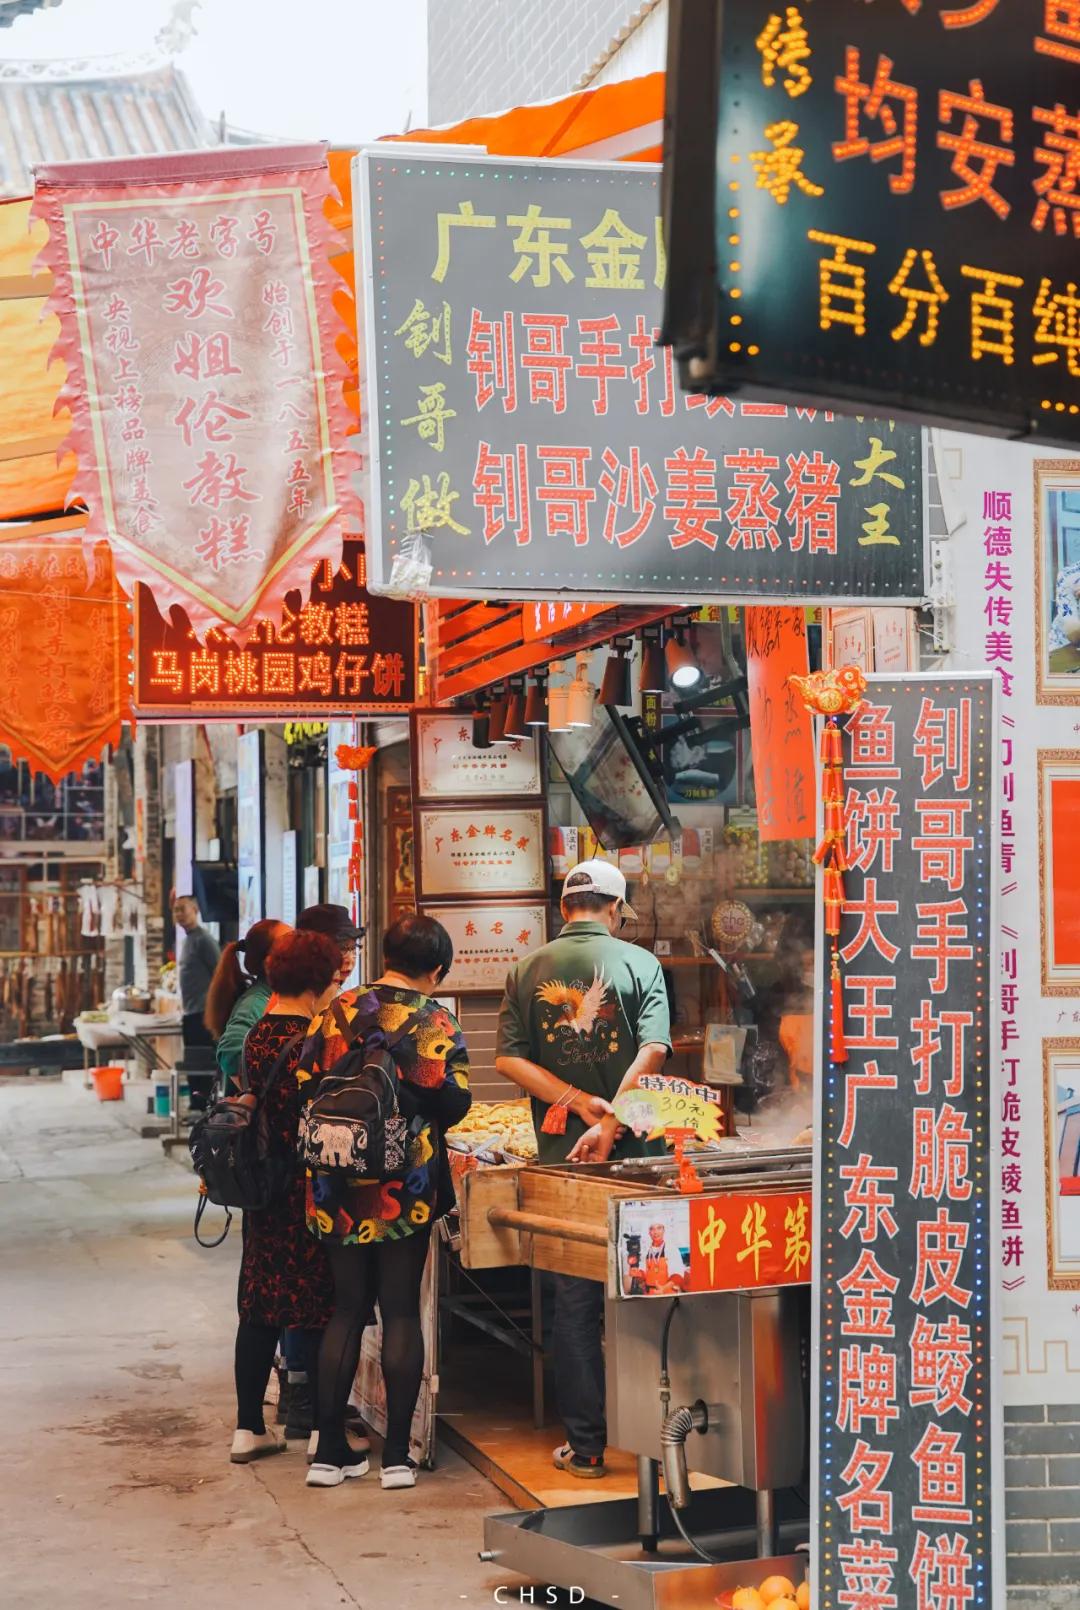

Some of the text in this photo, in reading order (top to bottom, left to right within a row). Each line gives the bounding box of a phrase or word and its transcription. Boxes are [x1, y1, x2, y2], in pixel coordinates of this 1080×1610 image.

[90, 209, 279, 268] 中华老字号
[430, 201, 665, 292] 广东金
[102, 293, 164, 538] 央视上榜品牌美食
[165, 266, 267, 573] 欢姐伦教糕
[262, 279, 314, 521] 始创于一八五五年
[465, 307, 836, 424] 钊哥手打
[471, 440, 841, 556] 钊哥沙姜蒸猪
[849, 415, 905, 547] 大王
[149, 649, 406, 697] 马岗桃园鸡仔饼
[638, 1075, 721, 1105] 特价中
[835, 699, 904, 1610] 鱼饼大王广东金牌名菜
[908, 696, 976, 1610] 钊哥手打脆皮鲮鱼饼
[697, 1197, 812, 1288] 中华第
